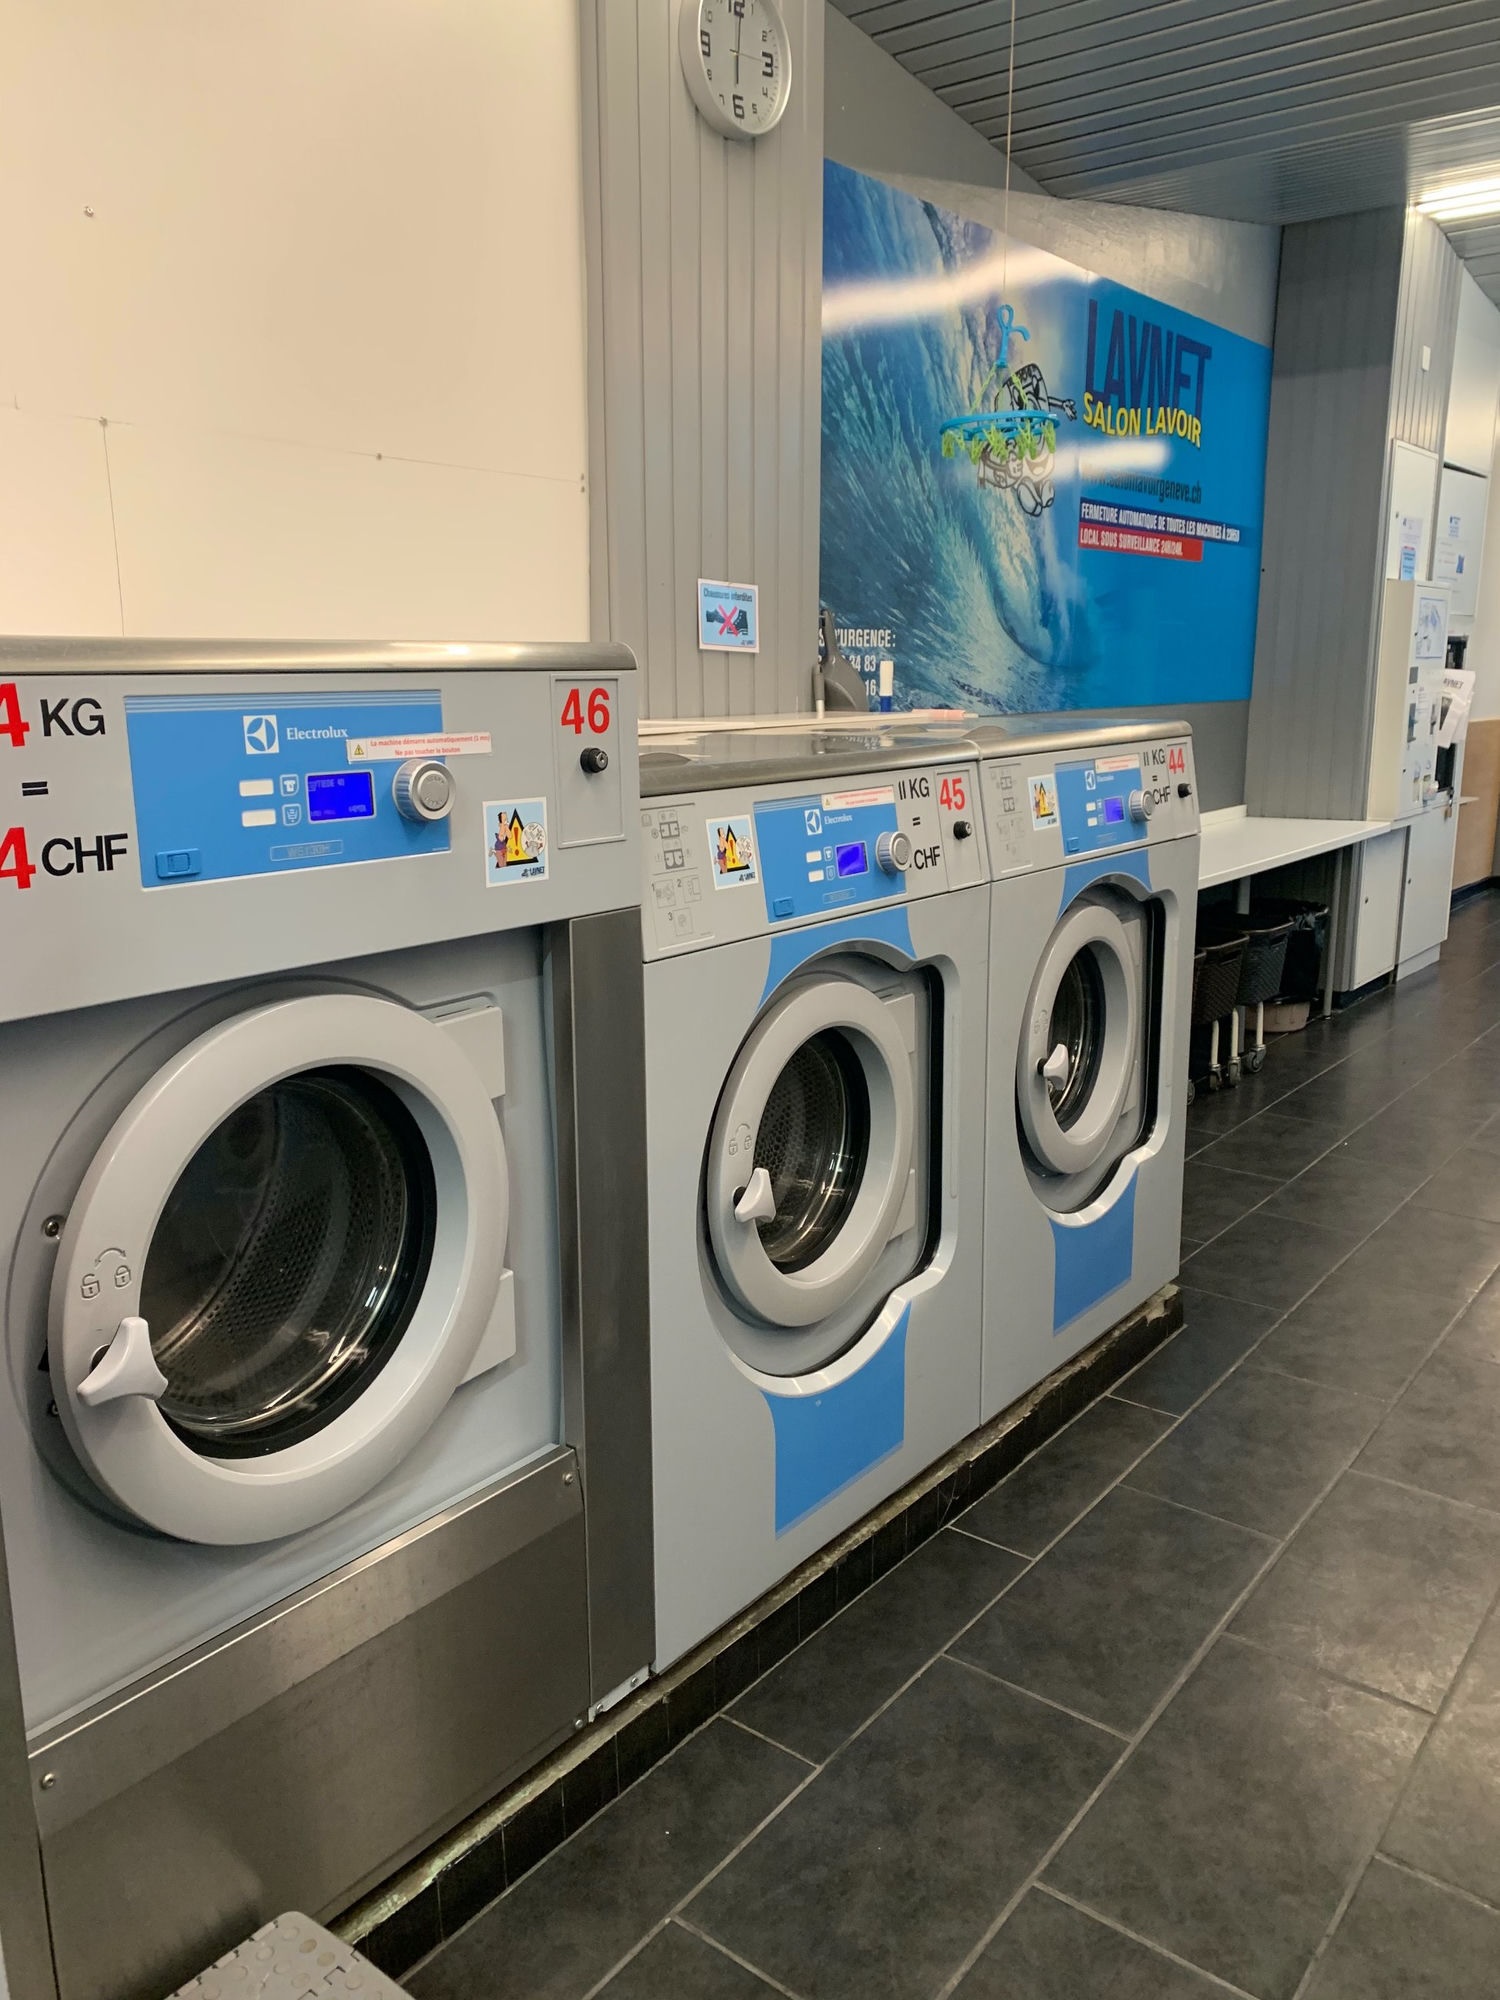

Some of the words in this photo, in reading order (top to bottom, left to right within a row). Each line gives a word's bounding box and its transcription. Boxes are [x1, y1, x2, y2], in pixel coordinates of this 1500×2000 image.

[761, 51, 774, 78] 3
[732, 94, 745, 119] 6
[1085, 298, 1212, 422] LAVNET
[1083, 391, 1141, 437] SALON
[1146, 406, 1202, 449] LAVOIR
[1081, 502, 1118, 523] FERMETURE
[1119, 509, 1157, 531] AUTOMATIQUE
[1157, 516, 1166, 530] DE
[1186, 520, 1196, 536] LES
[1080, 528, 1099, 545] LOCAL
[1100, 531, 1118, 549] SOUS
[864, 655, 876, 672] 83
[865, 679, 876, 696] 16
[39, 697, 106, 737] KG
[561, 687, 610, 735] 46
[286, 726, 348, 741] Electrolux
[378, 739, 402, 747] machine
[1151, 748, 1166, 766] KG
[1168, 748, 1185, 775] 44
[909, 777, 930, 799] KG
[939, 777, 966, 811] 45
[1153, 785, 1171, 805] CHF
[824, 814, 853, 825] Electrolux
[41, 833, 128, 877] CHF
[914, 845, 940, 870] CHF
